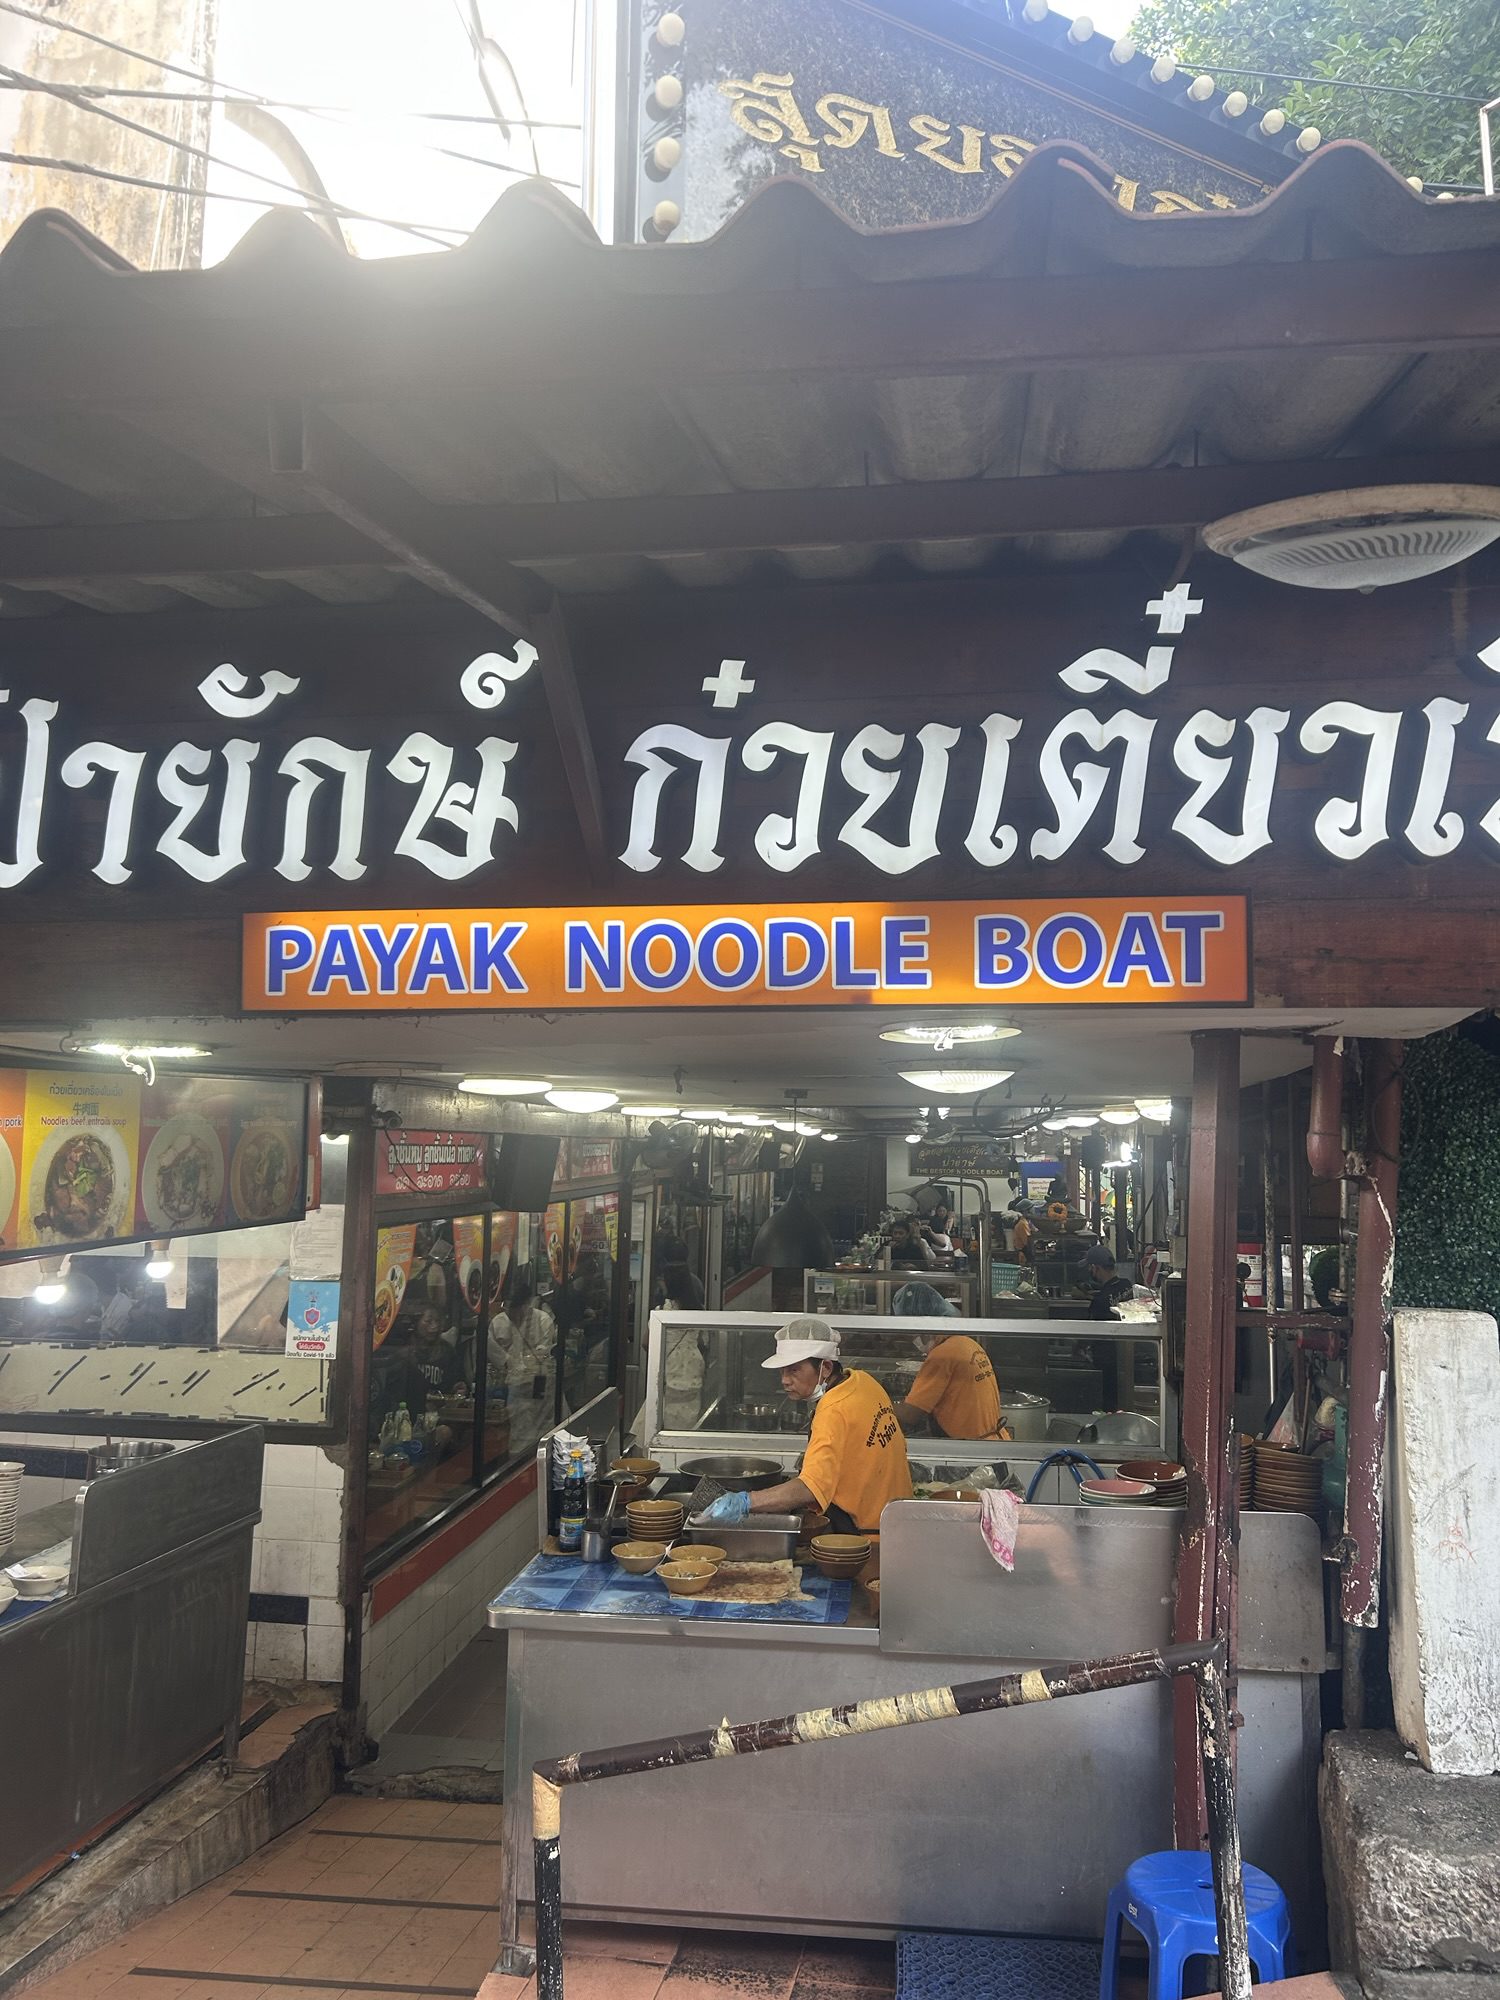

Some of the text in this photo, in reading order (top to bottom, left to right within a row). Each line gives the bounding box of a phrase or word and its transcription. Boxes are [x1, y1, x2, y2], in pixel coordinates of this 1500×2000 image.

[617, 582, 1500, 875] ก๋วยเตี๋ยวเ
[265, 910, 1225, 996] PAYAK NOODLE BOAT
[5, 1114, 23, 1130] pork
[41, 1116, 69, 1126] Noodles
[71, 1116, 86, 1126] beef
